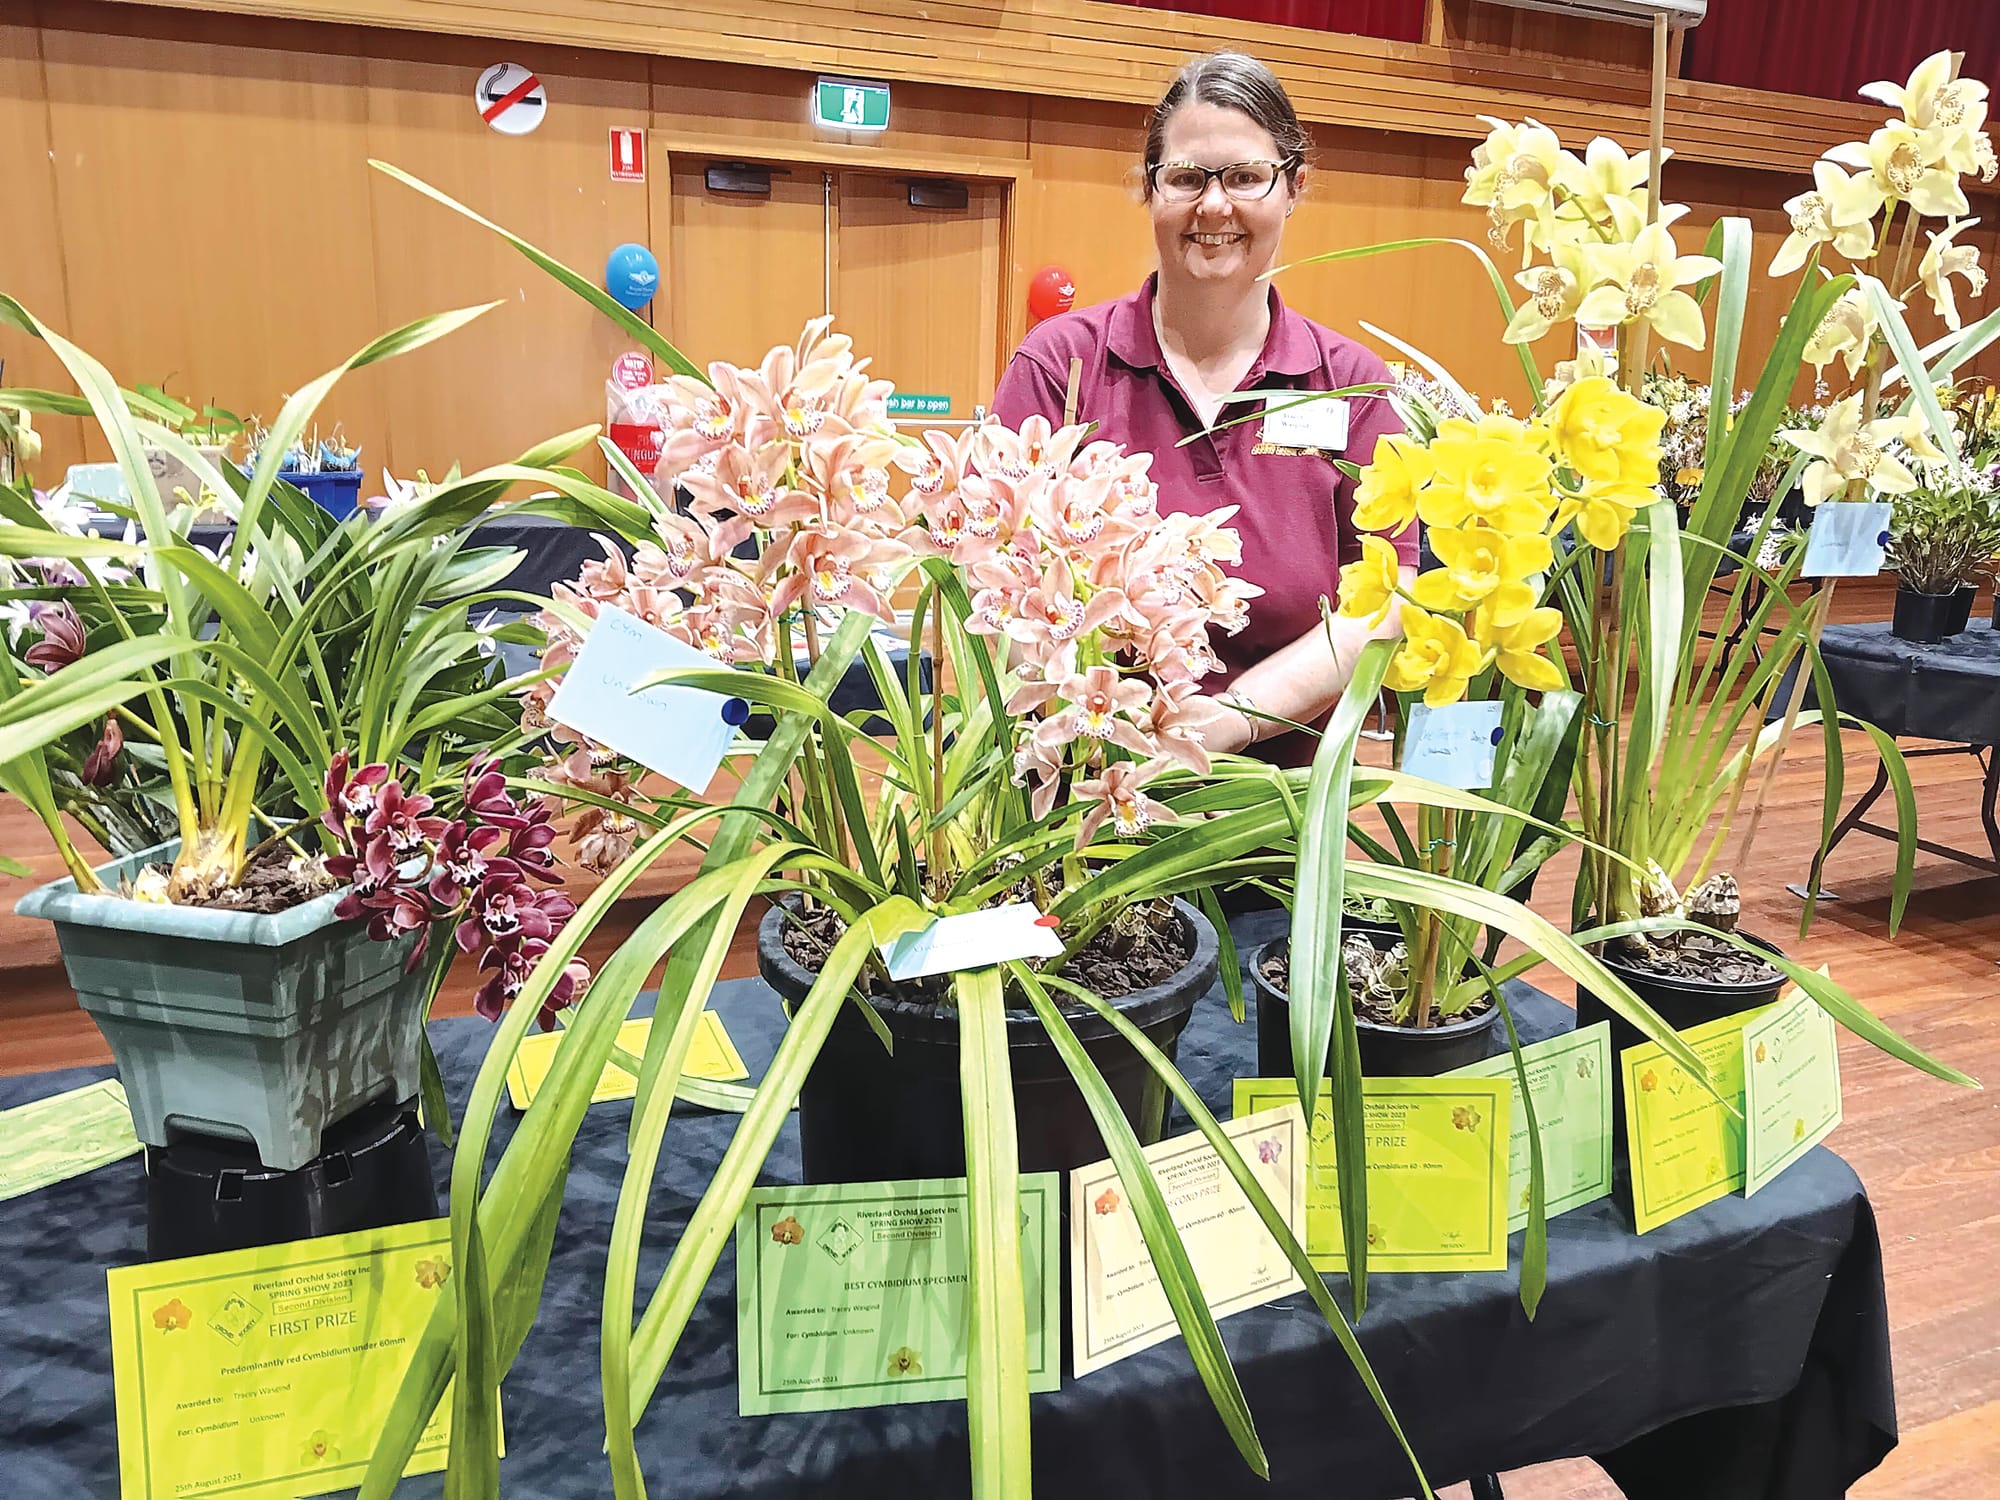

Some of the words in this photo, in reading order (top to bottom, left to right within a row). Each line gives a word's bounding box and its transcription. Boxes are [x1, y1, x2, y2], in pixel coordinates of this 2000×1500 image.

[901, 398, 915, 409] bar
[917, 398, 926, 409] to
[927, 400, 948, 412] open
[1376, 1136, 1407, 1147] PRIZE
[857, 1210, 892, 1219] Riverland
[893, 1208, 918, 1217] Orchid
[920, 1207, 946, 1216] Society
[947, 1206, 959, 1214] Inc
[870, 1219, 897, 1228] SPRING
[899, 1218, 923, 1227] SHOW
[924, 1217, 943, 1225] 2023
[876, 1231, 906, 1239] Second
[906, 1229, 937, 1238] Division
[253, 1277, 295, 1292] Riverland
[295, 1273, 324, 1286] Orchid
[326, 1269, 357, 1281] Society
[358, 1266, 371, 1275] Inc
[844, 1281, 865, 1291] BEST
[867, 1278, 921, 1290] CYMBIDIUM
[922, 1274, 968, 1286] SPECIMEN
[269, 1288, 301, 1299] SPRING
[303, 1283, 330, 1295] SHOW
[333, 1279, 353, 1290] 2023
[277, 1298, 311, 1312] Second
[313, 1294, 348, 1307] Division
[786, 1307, 816, 1316] Awarded
[269, 1318, 310, 1337] FIRST
[315, 1310, 358, 1329] PRIZE
[801, 1330, 838, 1339] Cymbidium
[220, 1354, 284, 1376] Predominantly
[286, 1355, 301, 1365] red
[303, 1347, 350, 1363] Cymbidium
[352, 1342, 377, 1353] under
[379, 1336, 406, 1348] 60mm
[176, 1397, 211, 1411] Awarded
[212, 1395, 224, 1404] to:
[177, 1428, 194, 1438] For:
[195, 1419, 239, 1434] Cymbidium
[249, 1412, 286, 1424] Unknown
[175, 1483, 193, 1494] 25th
[194, 1477, 222, 1490] August
[223, 1472, 242, 1485] 2023
